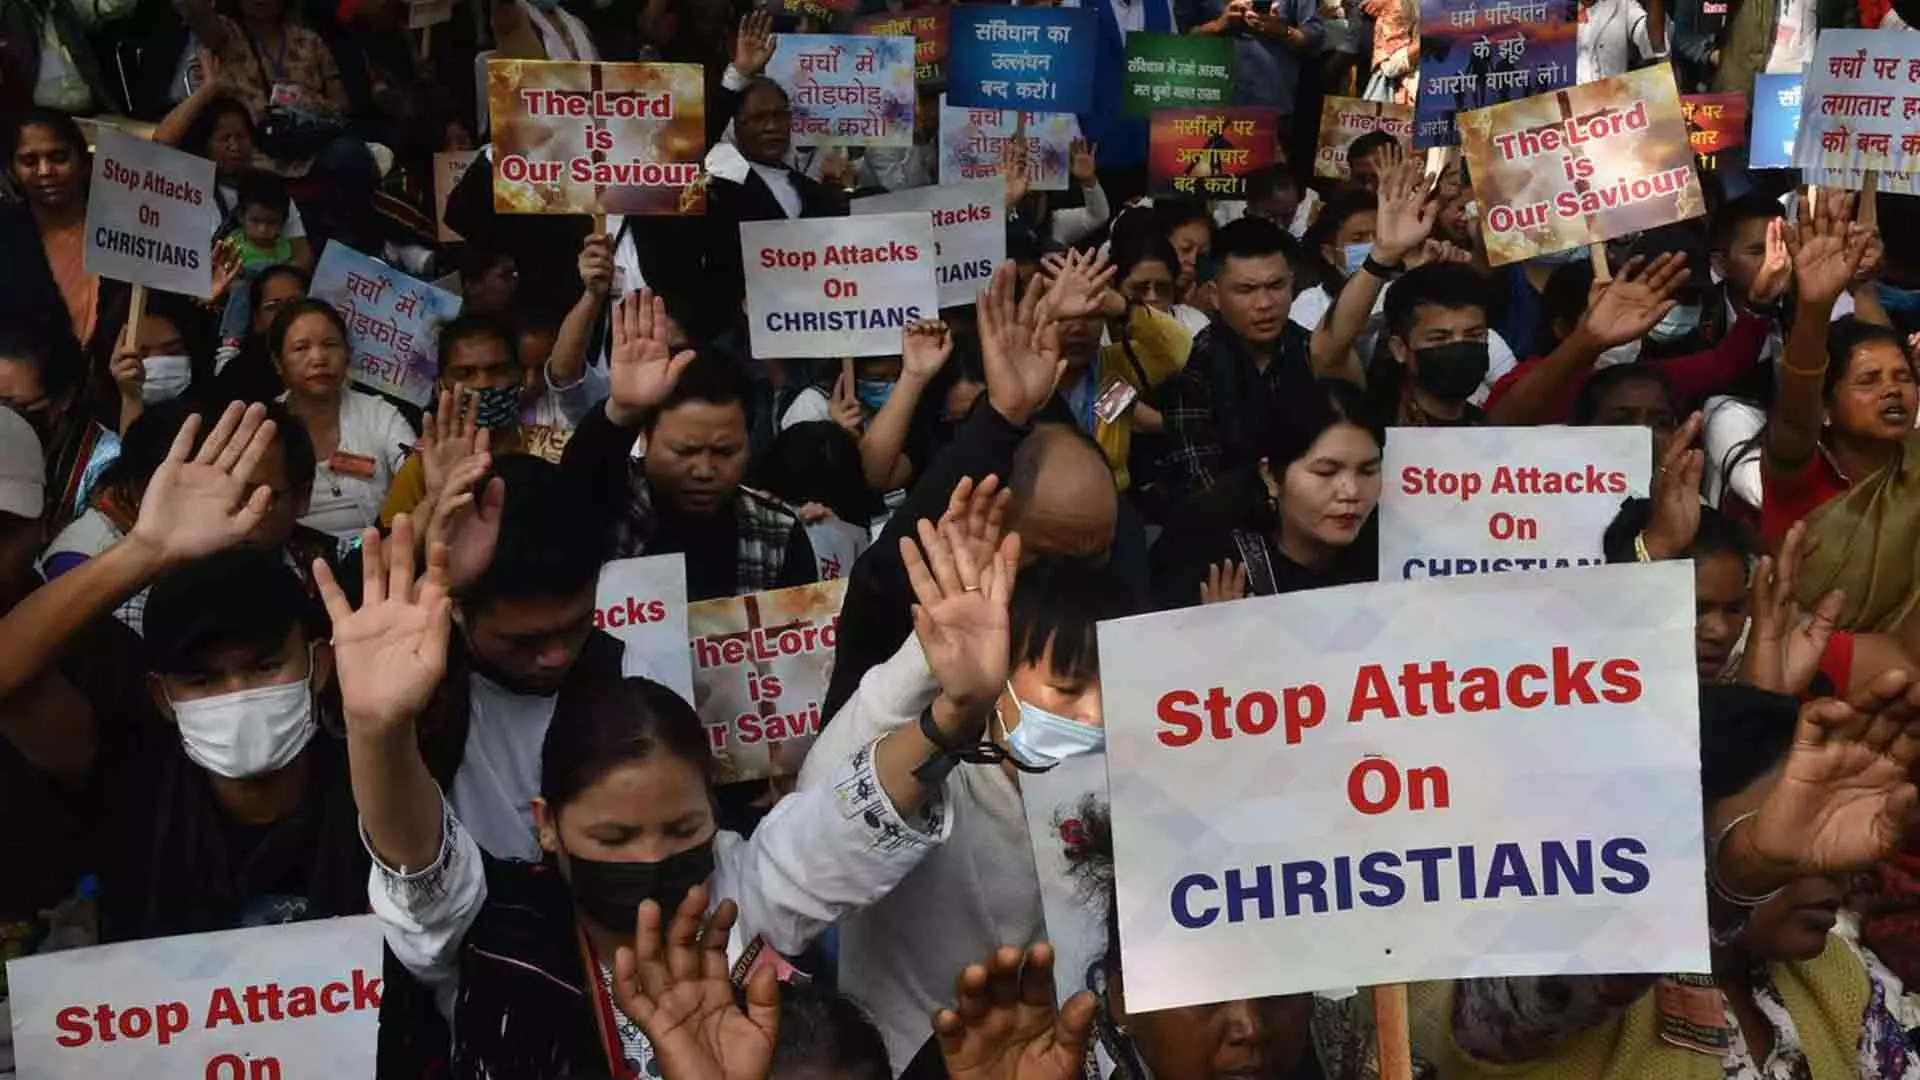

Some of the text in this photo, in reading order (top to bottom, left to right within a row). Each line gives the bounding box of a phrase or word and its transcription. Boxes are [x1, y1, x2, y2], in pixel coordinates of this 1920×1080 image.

[1047, 25, 1072, 44] का
[1471, 35, 1492, 59] के
[1427, 69, 1478, 96] आरोप
[1486, 69, 1531, 90] वापस
[1873, 57, 1901, 80] पर
[522, 90, 673, 119] The Lord
[1821, 94, 1896, 118] लगातार
[584, 124, 614, 150] is
[1231, 118, 1257, 138] पर
[1340, 113, 1373, 132] The
[1495, 128, 1560, 161] The
[1566, 102, 1649, 146] Lord
[1821, 124, 1849, 153] को
[1857, 132, 1894, 157] बन्द
[103, 158, 203, 206] Stop Attacks
[501, 156, 699, 185] Our Saviour
[1563, 154, 1595, 181] is
[1489, 166, 1690, 233] Our Saviour
[138, 204, 160, 229] On
[931, 203, 992, 228] ttacks
[95, 227, 200, 270] CHRISTIANS
[760, 248, 817, 271] Stop
[823, 241, 919, 267] Attacks
[823, 278, 858, 299] On
[1401, 464, 1628, 501] Stop Attacks
[1488, 511, 1538, 541] On
[593, 596, 666, 631] acks
[694, 637, 746, 669] he
[747, 671, 783, 702] is
[1155, 646, 1642, 747] Stop Attacks
[735, 702, 822, 744] Savi
[1347, 757, 1450, 815] On
[1170, 837, 1651, 930] CHRISTIANS
[55, 968, 383, 1048] Stop Attack
[205, 1053, 281, 1080] On
